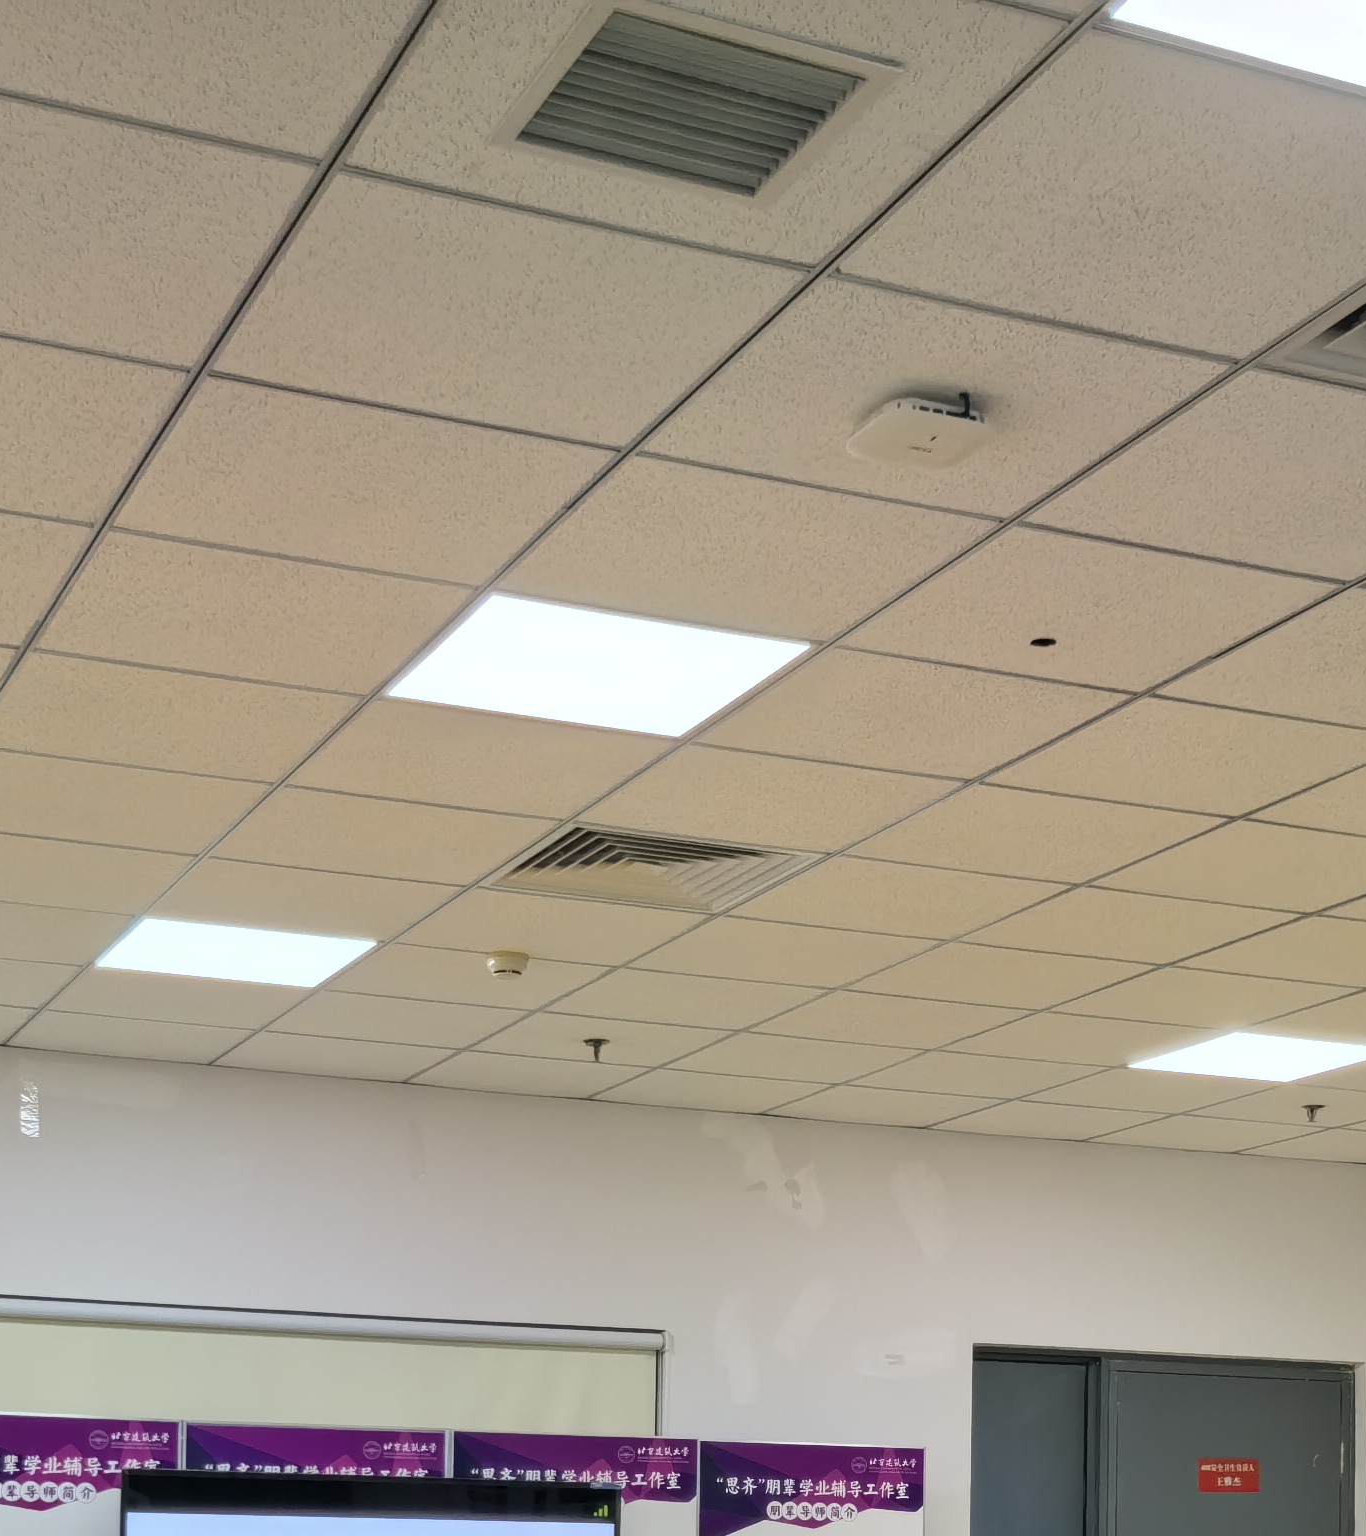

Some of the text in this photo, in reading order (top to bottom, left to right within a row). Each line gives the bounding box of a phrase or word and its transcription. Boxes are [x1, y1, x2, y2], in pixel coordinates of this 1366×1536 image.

[716, 1476, 909, 1499] “思齐”朋辈学业辅导工作室
[770, 1503, 856, 1519] 朋辈导师简介
